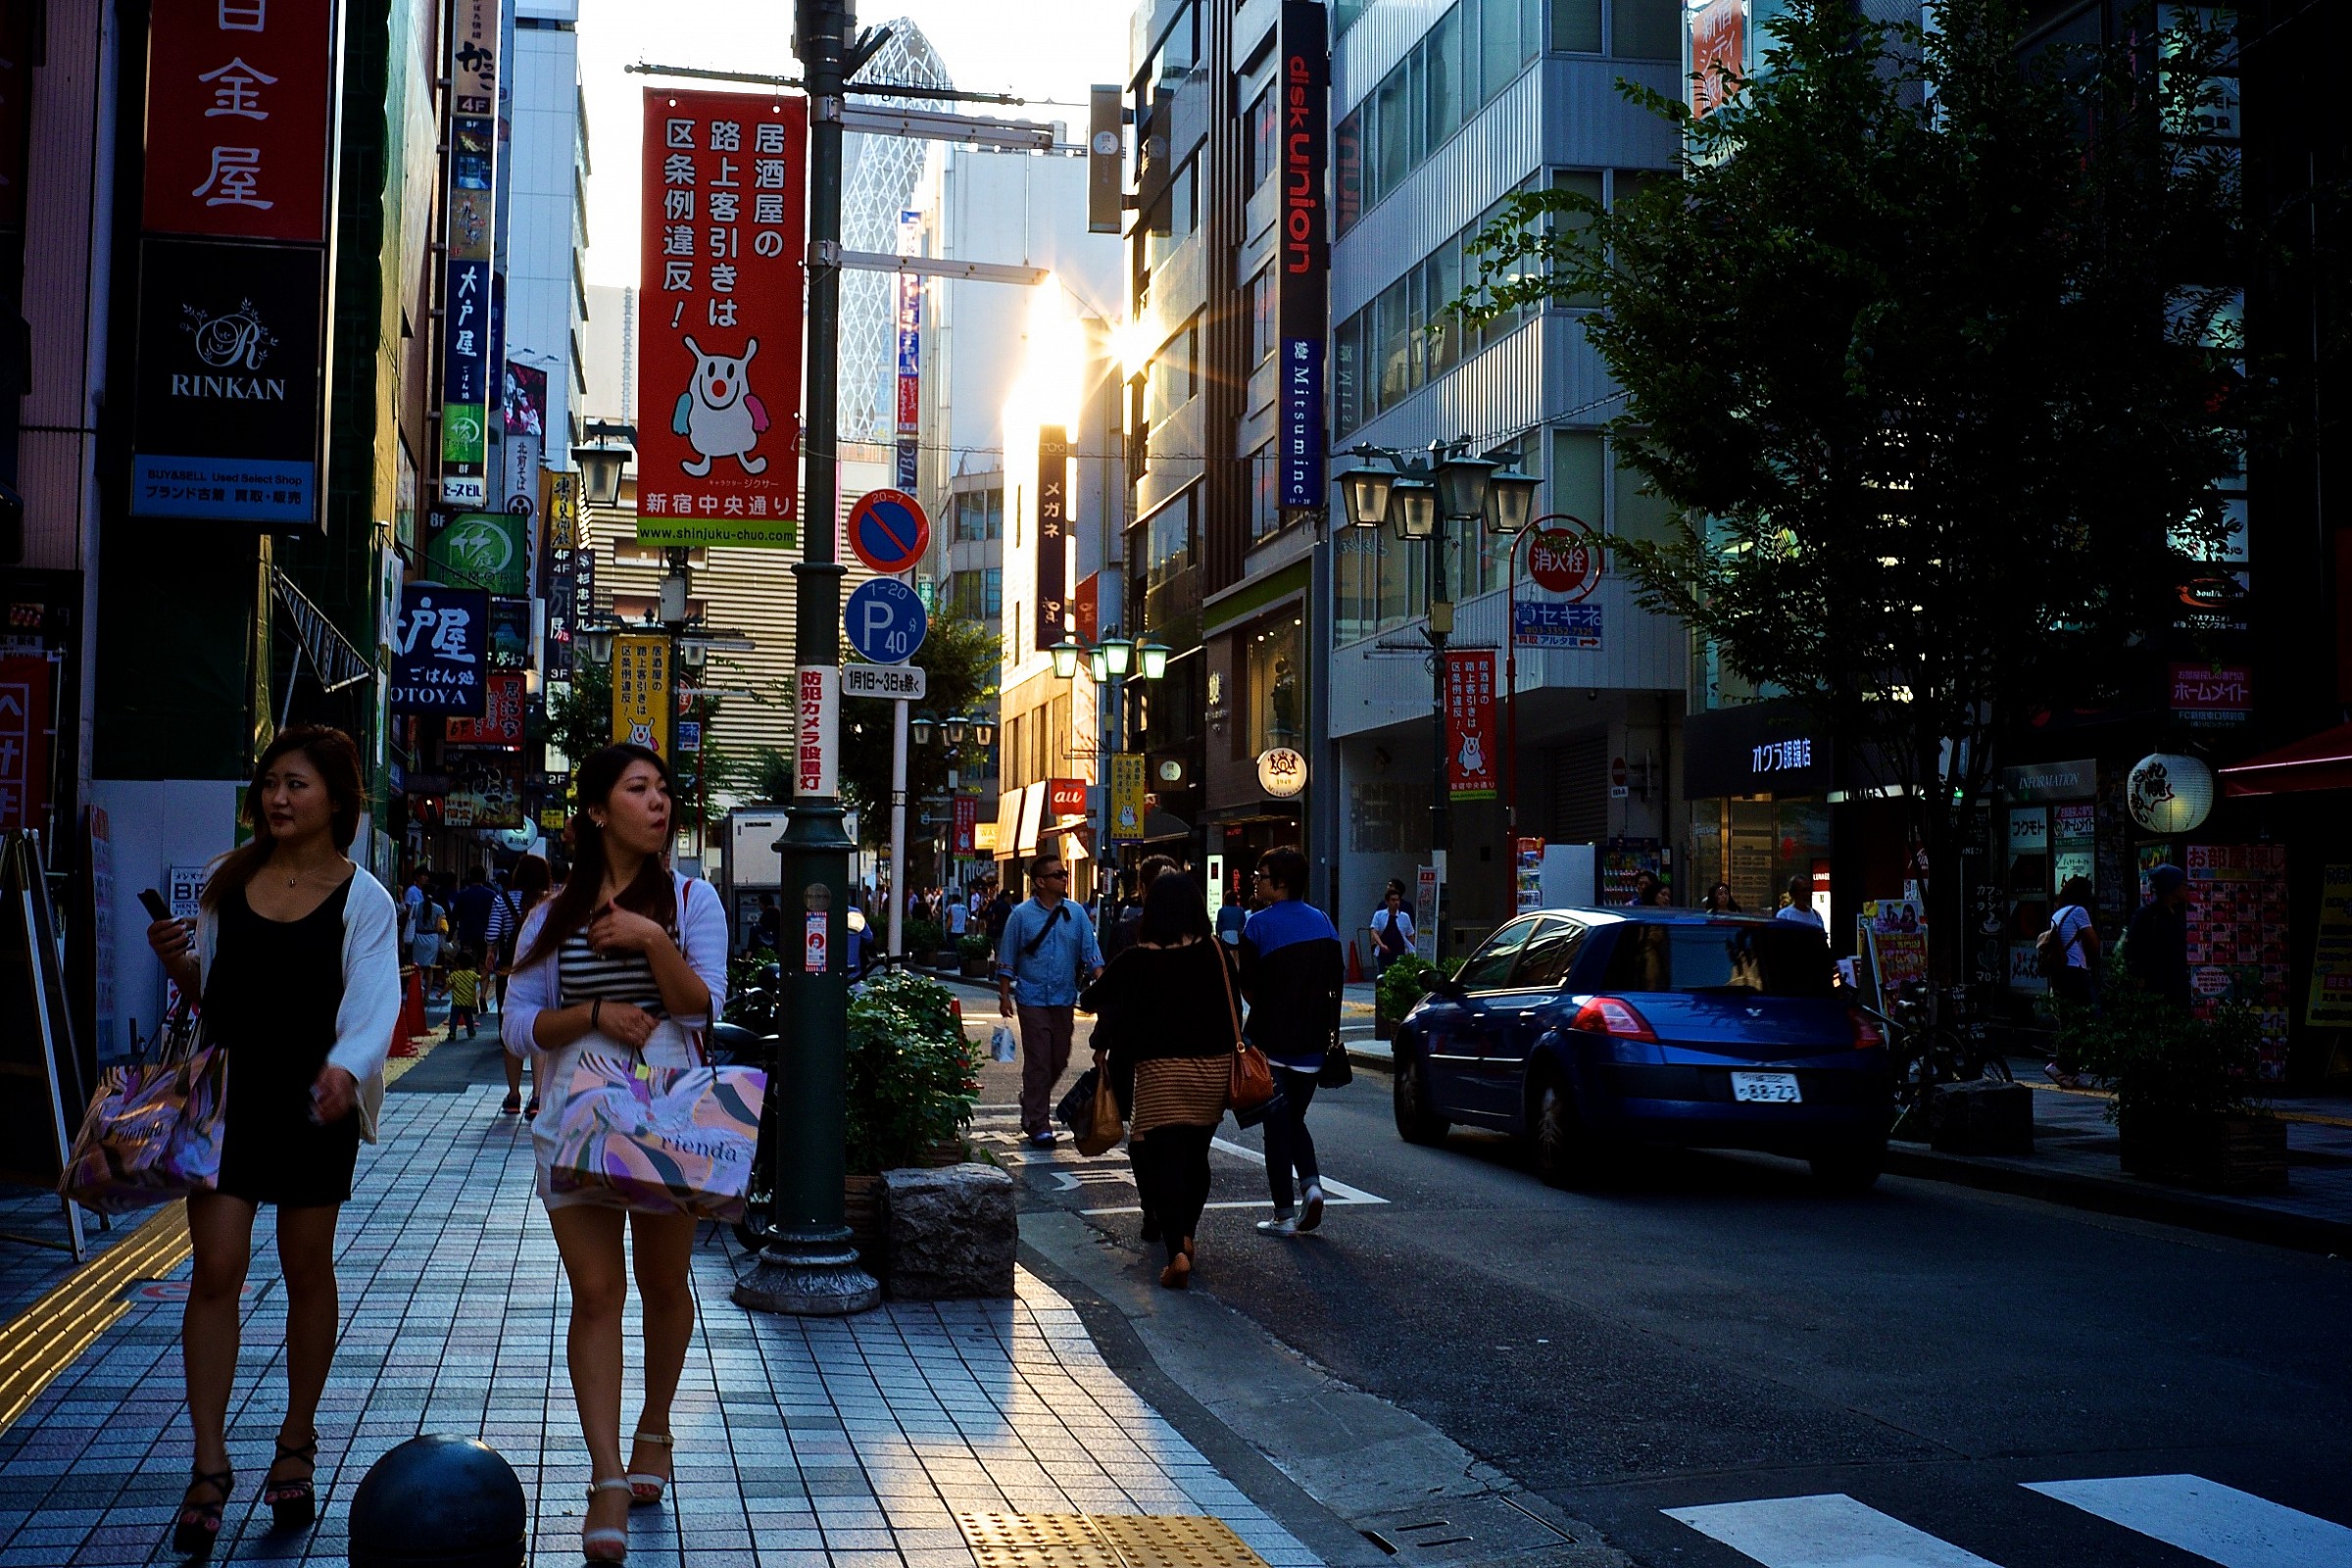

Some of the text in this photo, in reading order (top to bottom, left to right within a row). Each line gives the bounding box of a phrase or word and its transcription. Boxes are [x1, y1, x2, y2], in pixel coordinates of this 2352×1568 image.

[461, 99, 487, 113] 4F
[754, 123, 785, 258] 居酒屋の
[710, 121, 741, 327] 路上客引きは
[456, 266, 477, 358] 大戸屋
[171, 373, 286, 401] RINKAN
[1294, 366, 1309, 495] Mitsumine
[899, 440, 916, 481] TBC
[212, 472, 239, 482] Used
[241, 473, 272, 484] Select
[274, 474, 303, 486] Shop
[146, 486, 225, 502] ブランド古着
[646, 492, 790, 516] 新宿中央通り
[871, 493, 904, 505] 20-7
[429, 512, 446, 528] 8F
[1044, 481, 1060, 538] メガネ
[639, 527, 794, 542] www.shinjuku-chuo.com
[554, 549, 569, 561] 4F
[1534, 548, 1586, 573] 消火栓
[553, 563, 570, 573] 4F
[866, 583, 909, 601] 7-20
[863, 600, 895, 653] P
[884, 631, 907, 655] 40
[410, 667, 474, 686] ごはん処
[550, 668, 568, 679] 3F
[2174, 681, 2249, 703] ホームメイト
[800, 670, 823, 792] 防犯カメラ設置灯
[1751, 737, 1812, 773] オグラ眼鏡店
[548, 773, 566, 785] 2F
[2019, 772, 2080, 790] INFORMATION
[1054, 790, 1083, 804] au
[2011, 819, 2046, 837] フクモト
[2187, 846, 2287, 869] お部屋探し
[660, 1134, 738, 1163] rienda
